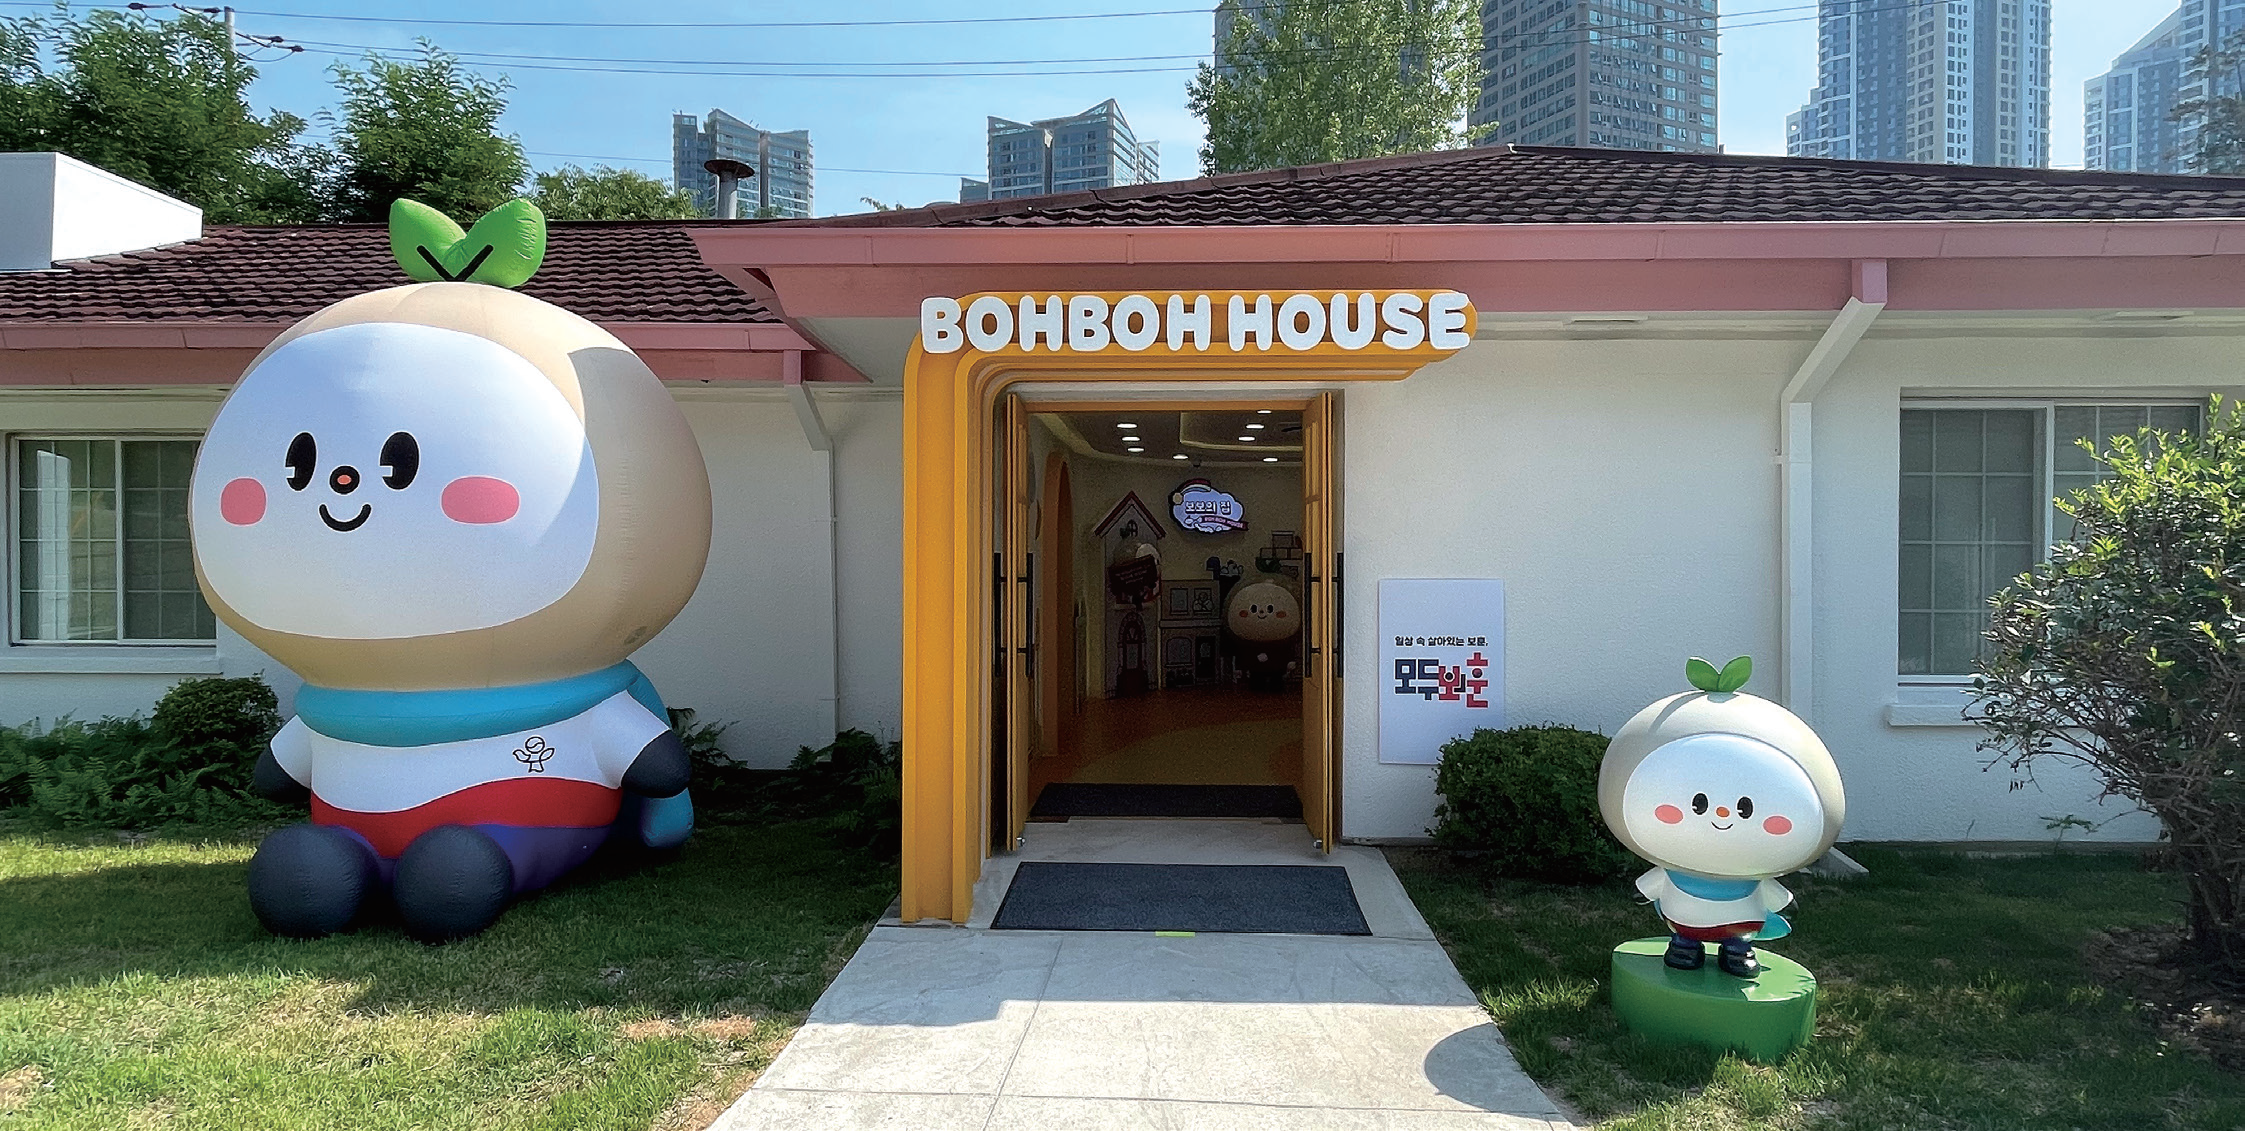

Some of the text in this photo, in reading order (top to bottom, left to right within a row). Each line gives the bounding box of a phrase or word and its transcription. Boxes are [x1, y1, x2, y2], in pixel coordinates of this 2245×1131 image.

[921, 293, 1471, 353] BOHBOH HOUSE
[1185, 501, 1231, 515] 보보의 집
[1394, 635, 1414, 647] 일상
[1416, 636, 1426, 647] 속
[1427, 636, 1465, 647] 살아있는
